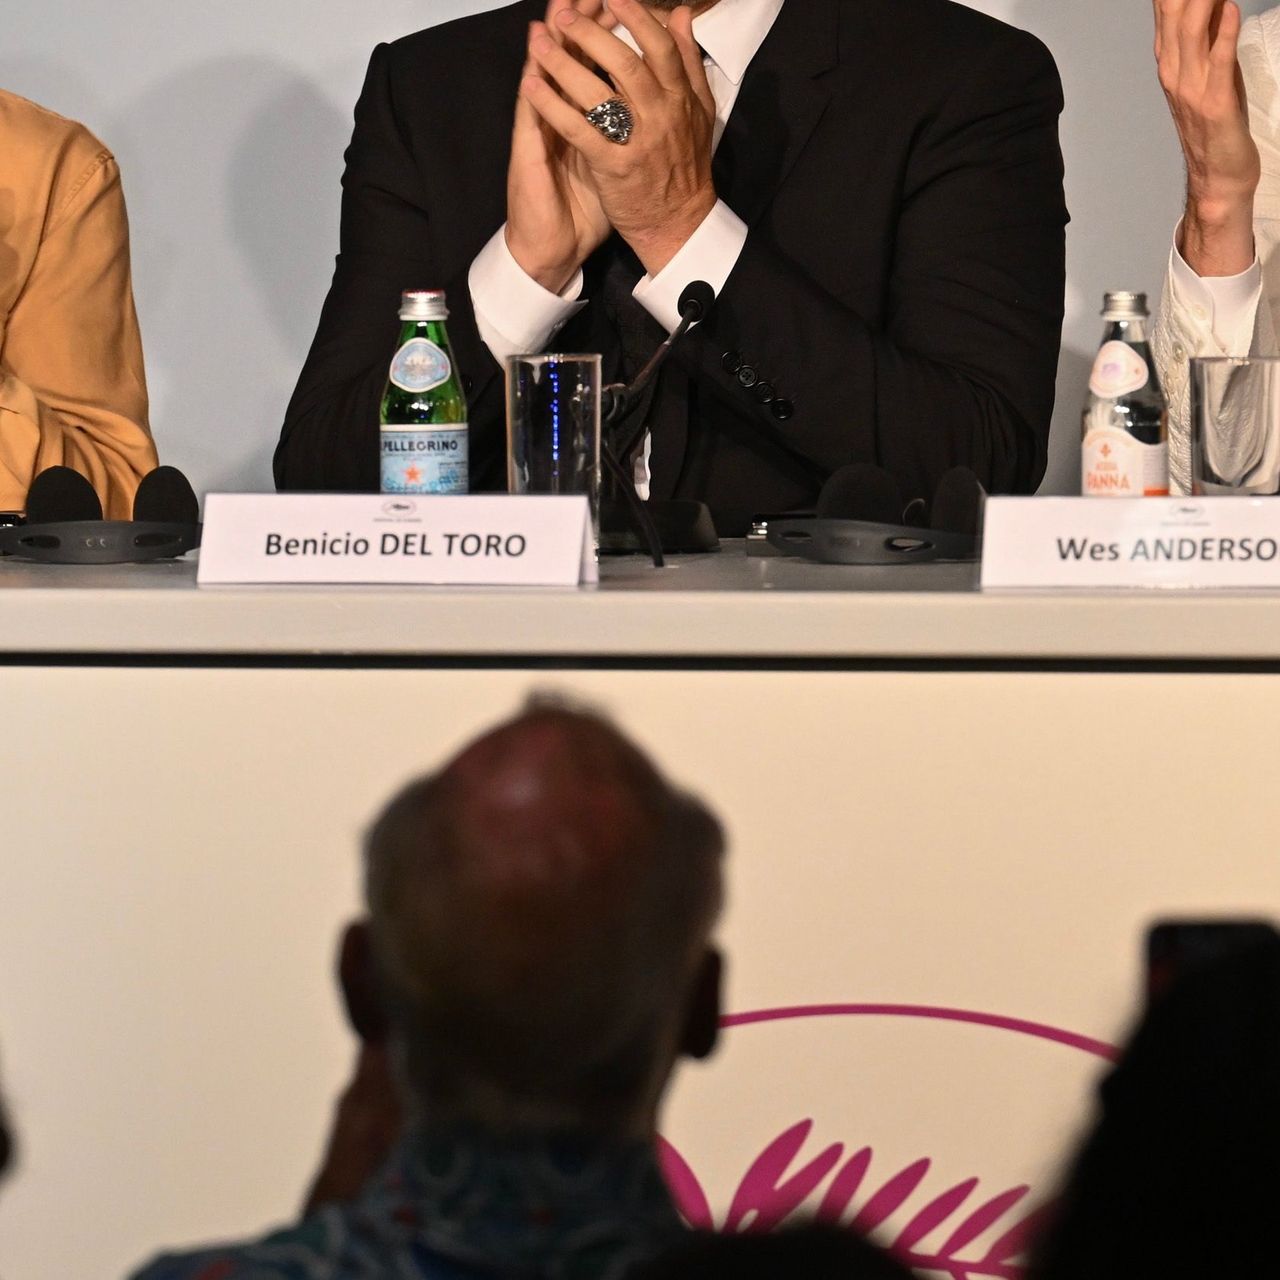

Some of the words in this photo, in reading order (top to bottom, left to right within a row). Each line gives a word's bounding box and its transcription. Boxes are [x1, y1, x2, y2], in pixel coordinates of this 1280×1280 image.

[265, 532, 370, 556] Benicio
[380, 533, 432, 556] DEL
[443, 533, 527, 557] TORO
[1056, 538, 1120, 561] Wes
